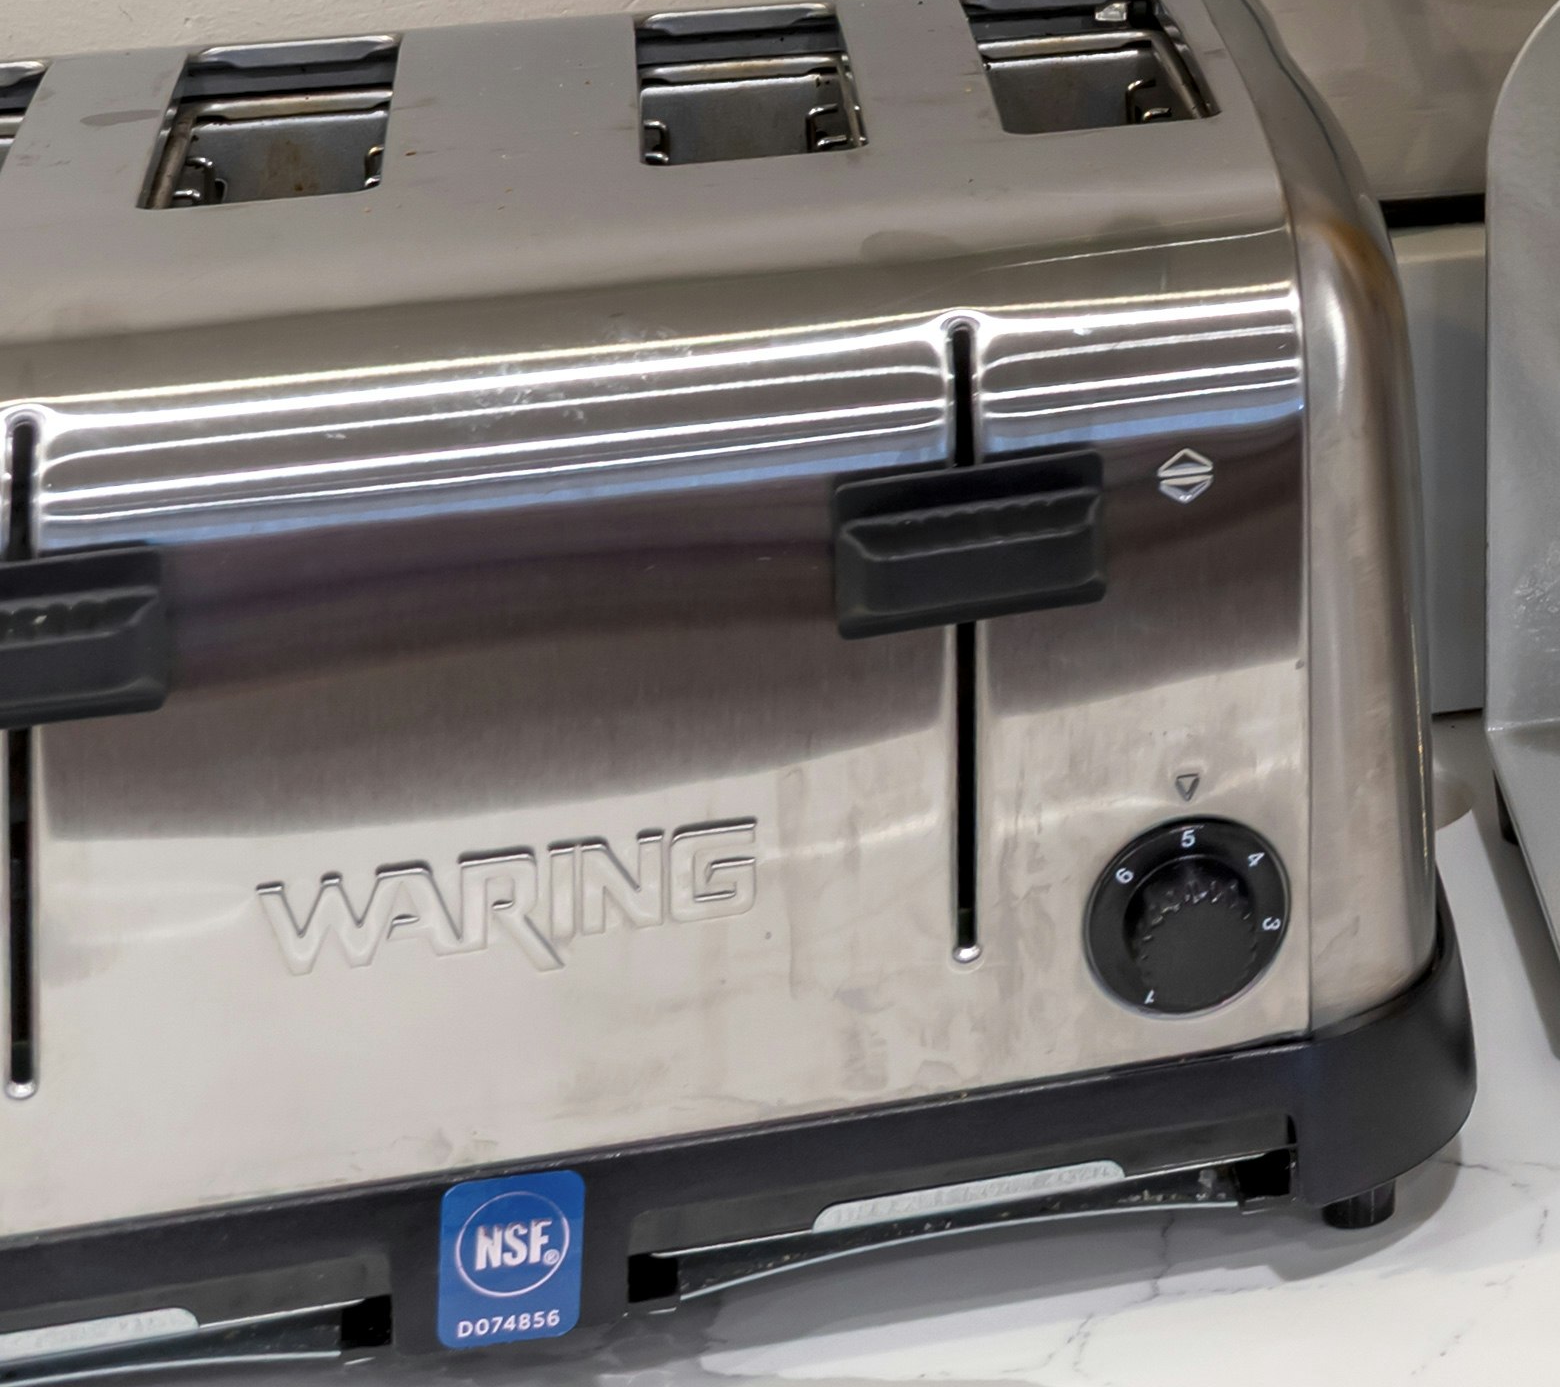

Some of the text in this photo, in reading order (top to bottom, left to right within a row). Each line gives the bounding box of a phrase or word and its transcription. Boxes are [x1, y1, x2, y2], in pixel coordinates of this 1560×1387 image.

[1180, 829, 1197, 848] 5
[1247, 852, 1265, 868] 4
[1115, 867, 1134, 884] 6
[256, 816, 758, 976] WARING
[1262, 916, 1281, 931] 3
[1144, 989, 1155, 1005] 1
[475, 1217, 553, 1271] NSF
[456, 1309, 561, 1339] D074856
